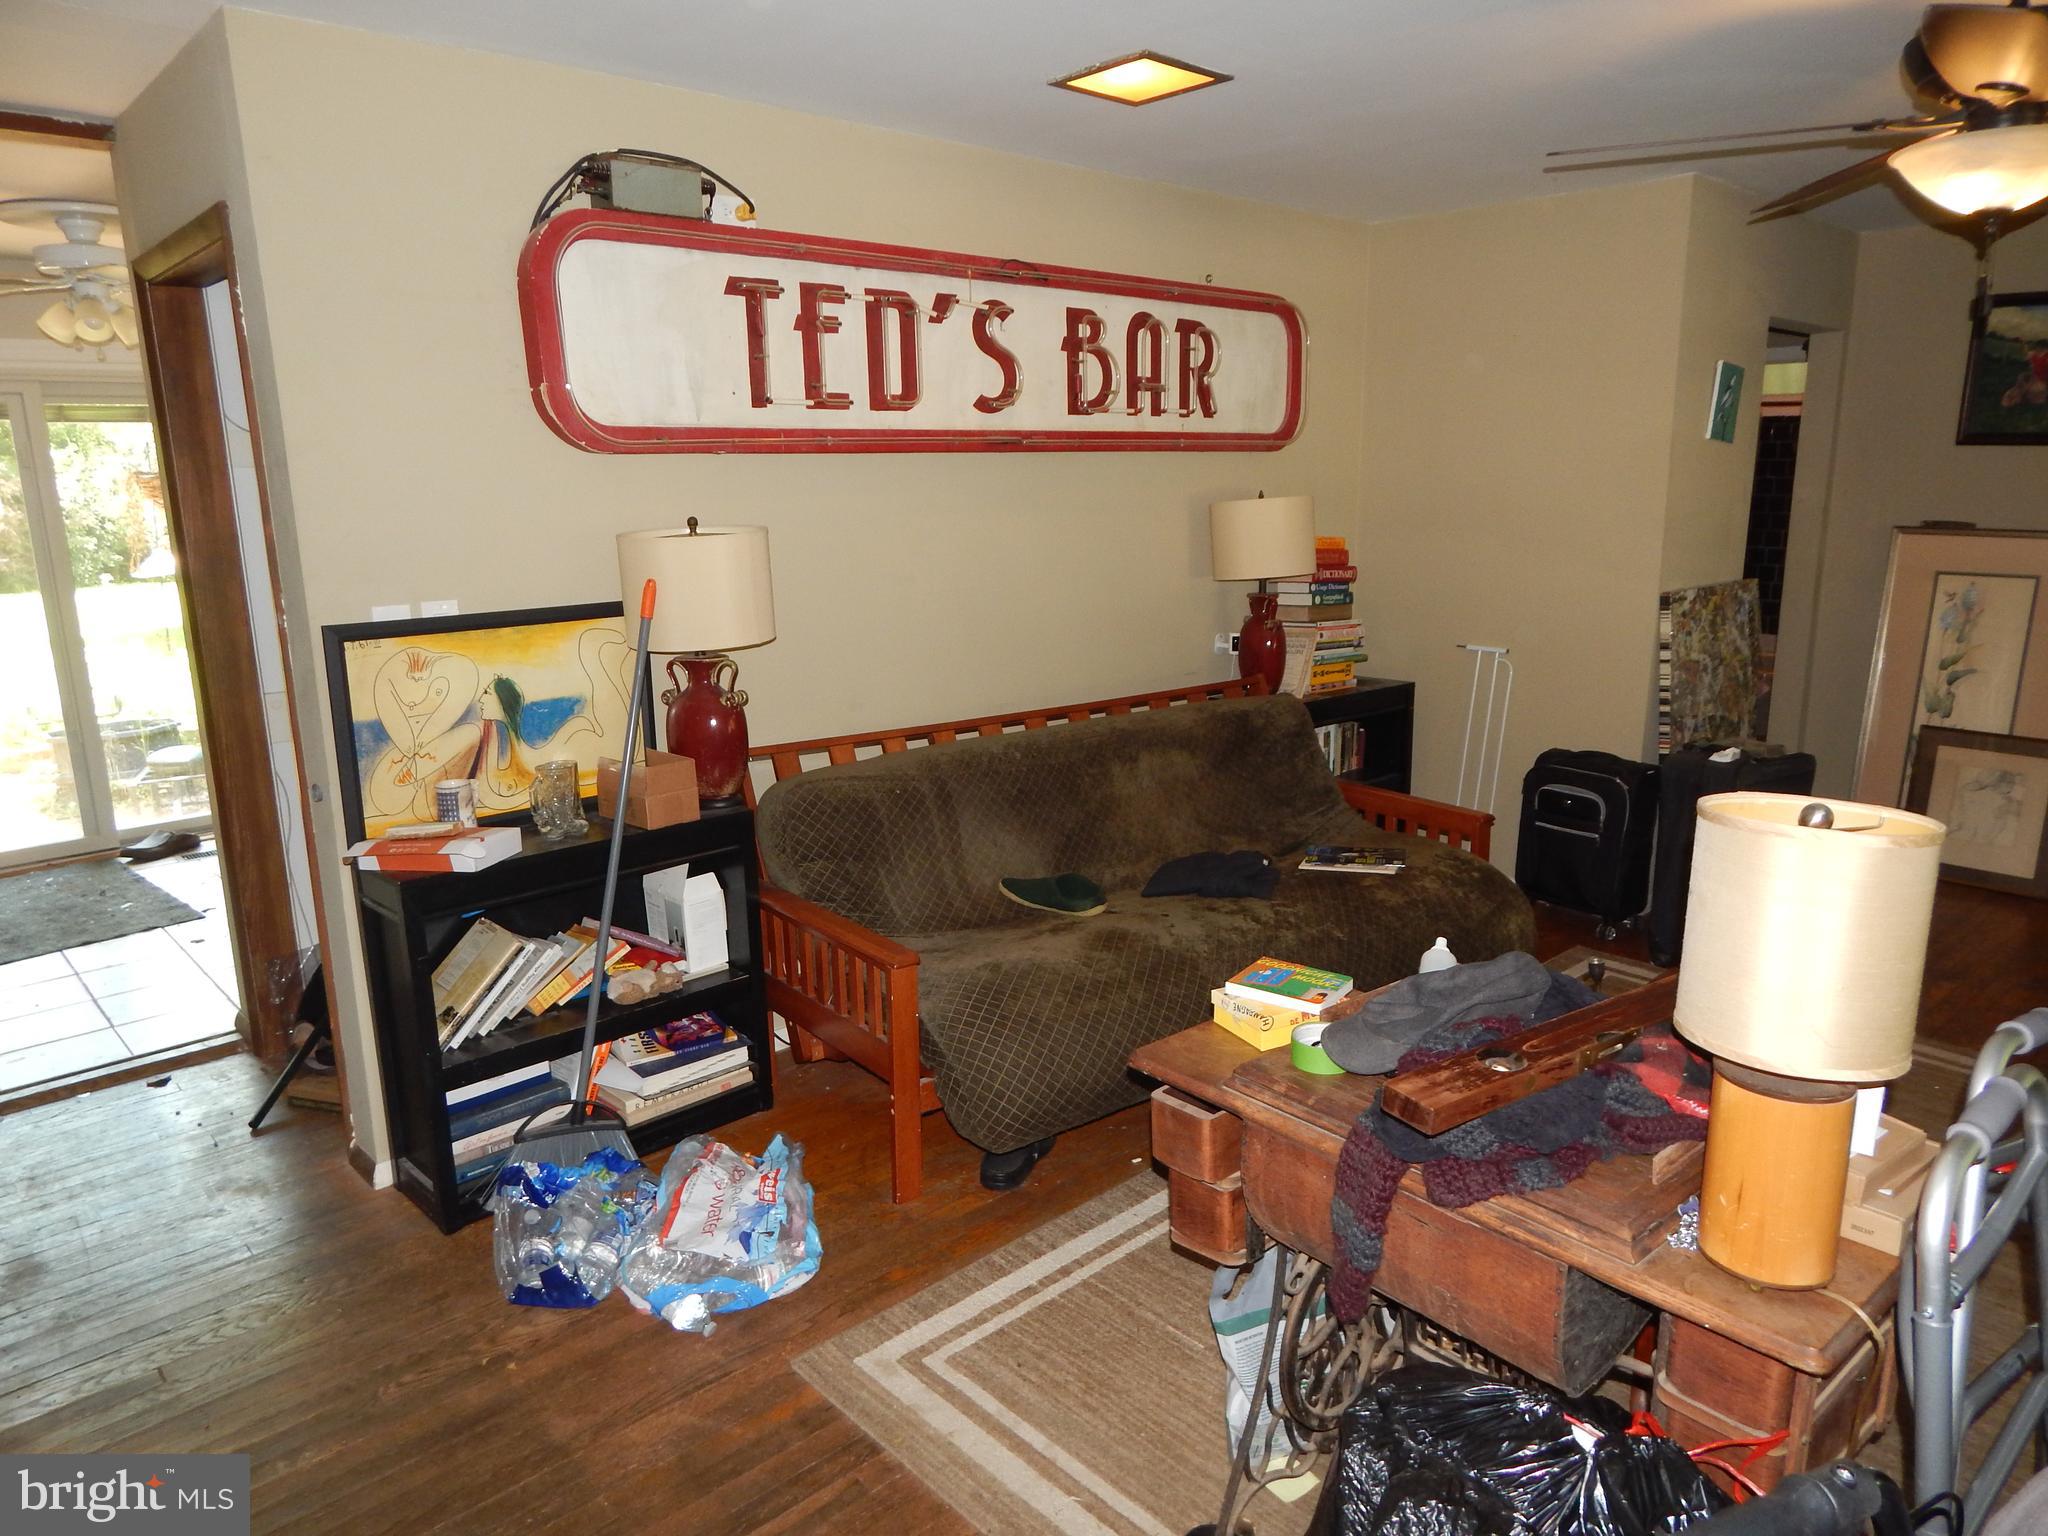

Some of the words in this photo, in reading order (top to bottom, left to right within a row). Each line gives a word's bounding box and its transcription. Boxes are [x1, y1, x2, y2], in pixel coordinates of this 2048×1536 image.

[724, 275, 1026, 414] TED'S
[1061, 307, 1223, 419] BAR
[700, 1192, 727, 1237] water
